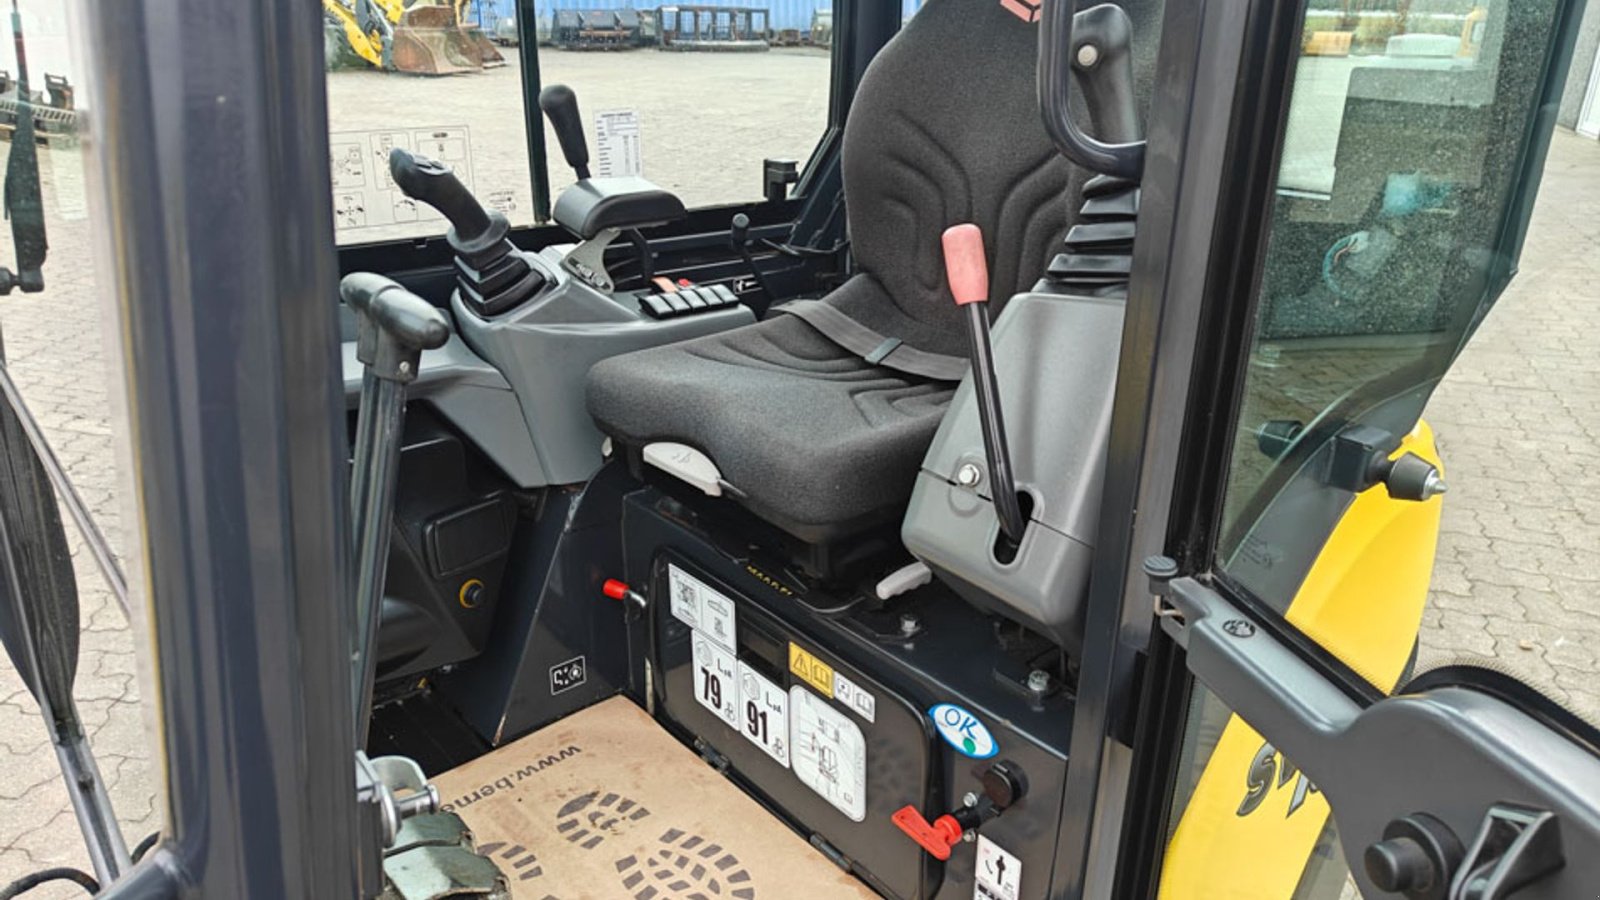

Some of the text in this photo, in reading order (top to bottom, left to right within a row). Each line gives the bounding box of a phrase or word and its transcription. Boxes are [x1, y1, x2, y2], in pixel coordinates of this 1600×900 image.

[701, 666, 721, 710] 79
[747, 700, 767, 745] 91
[945, 708, 977, 740] OK
